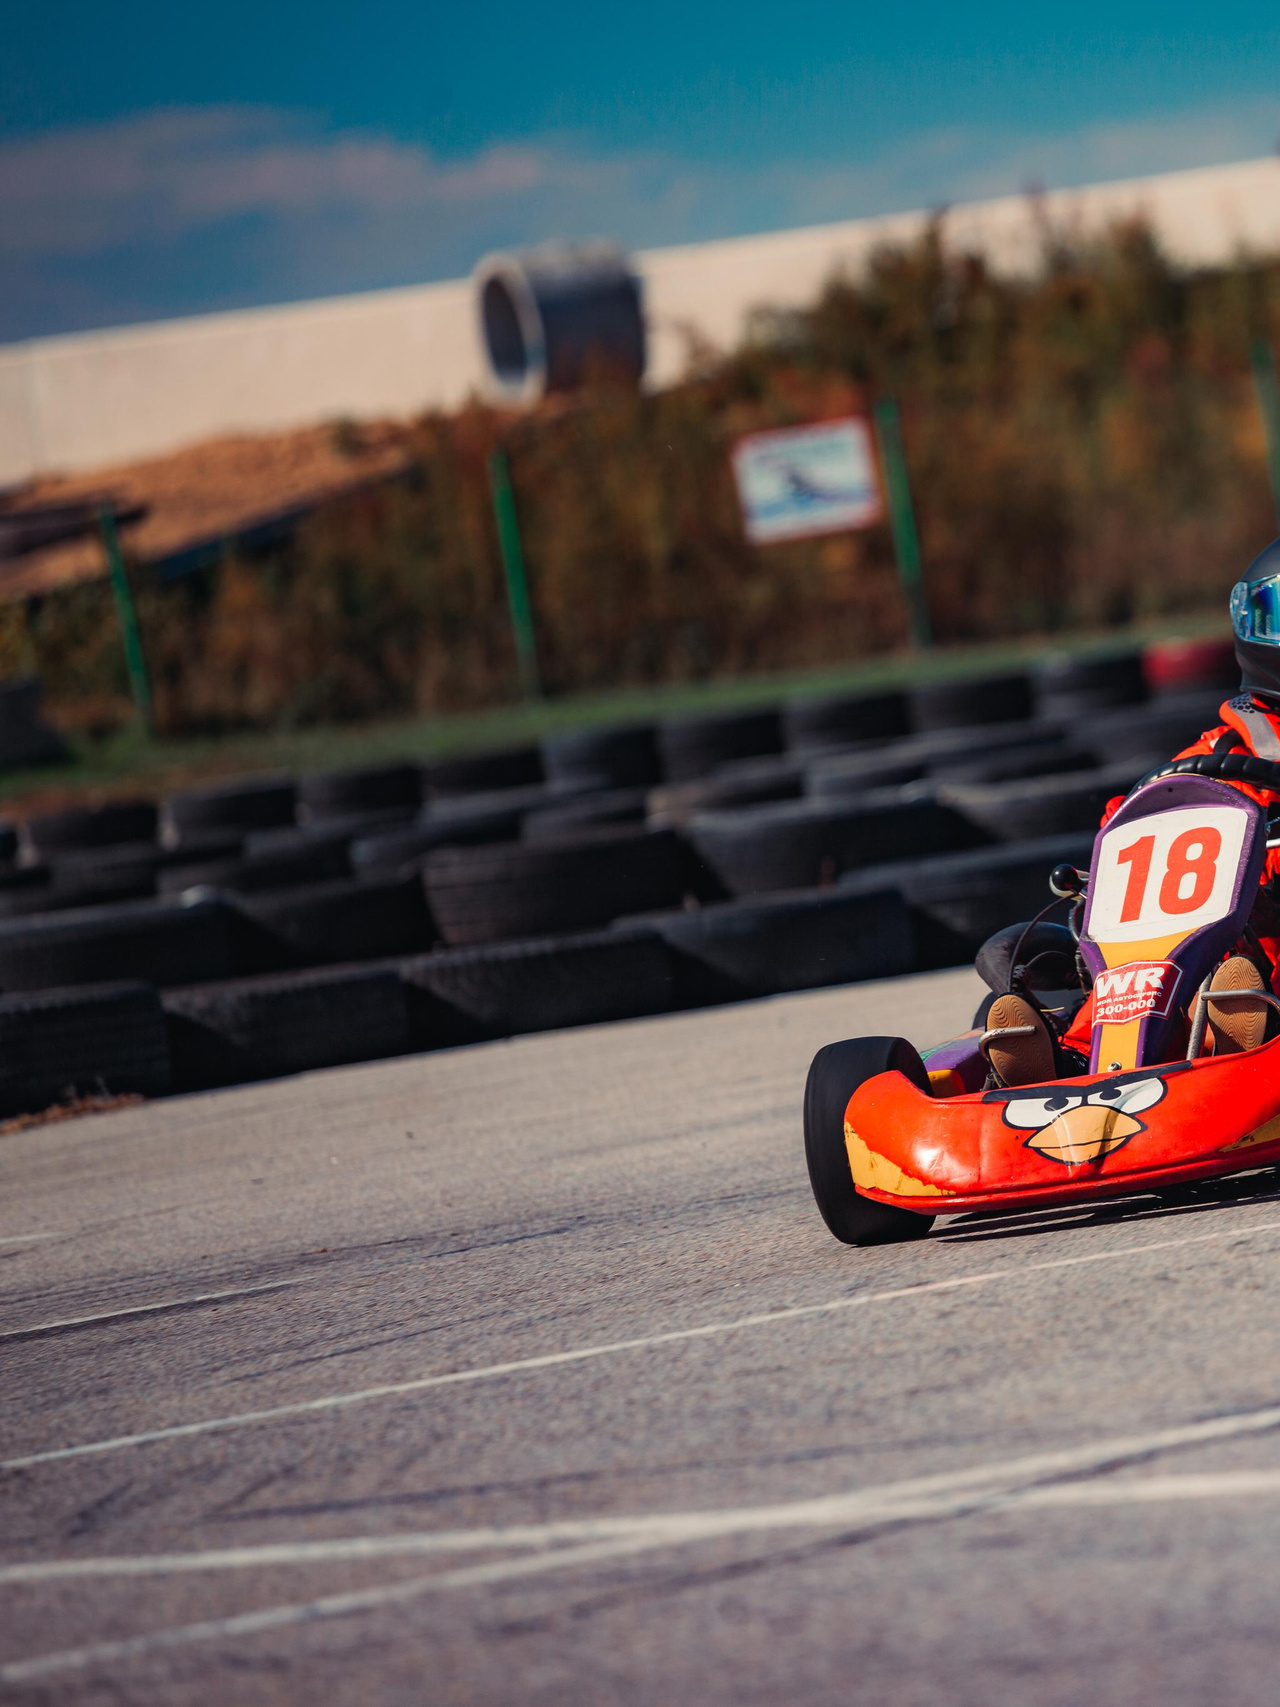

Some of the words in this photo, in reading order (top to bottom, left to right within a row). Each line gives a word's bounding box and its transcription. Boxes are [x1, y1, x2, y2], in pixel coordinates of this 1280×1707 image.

[1117, 826, 1222, 923] 18
[1096, 967, 1164, 999] WR
[1096, 999, 1156, 1017] 300-000
